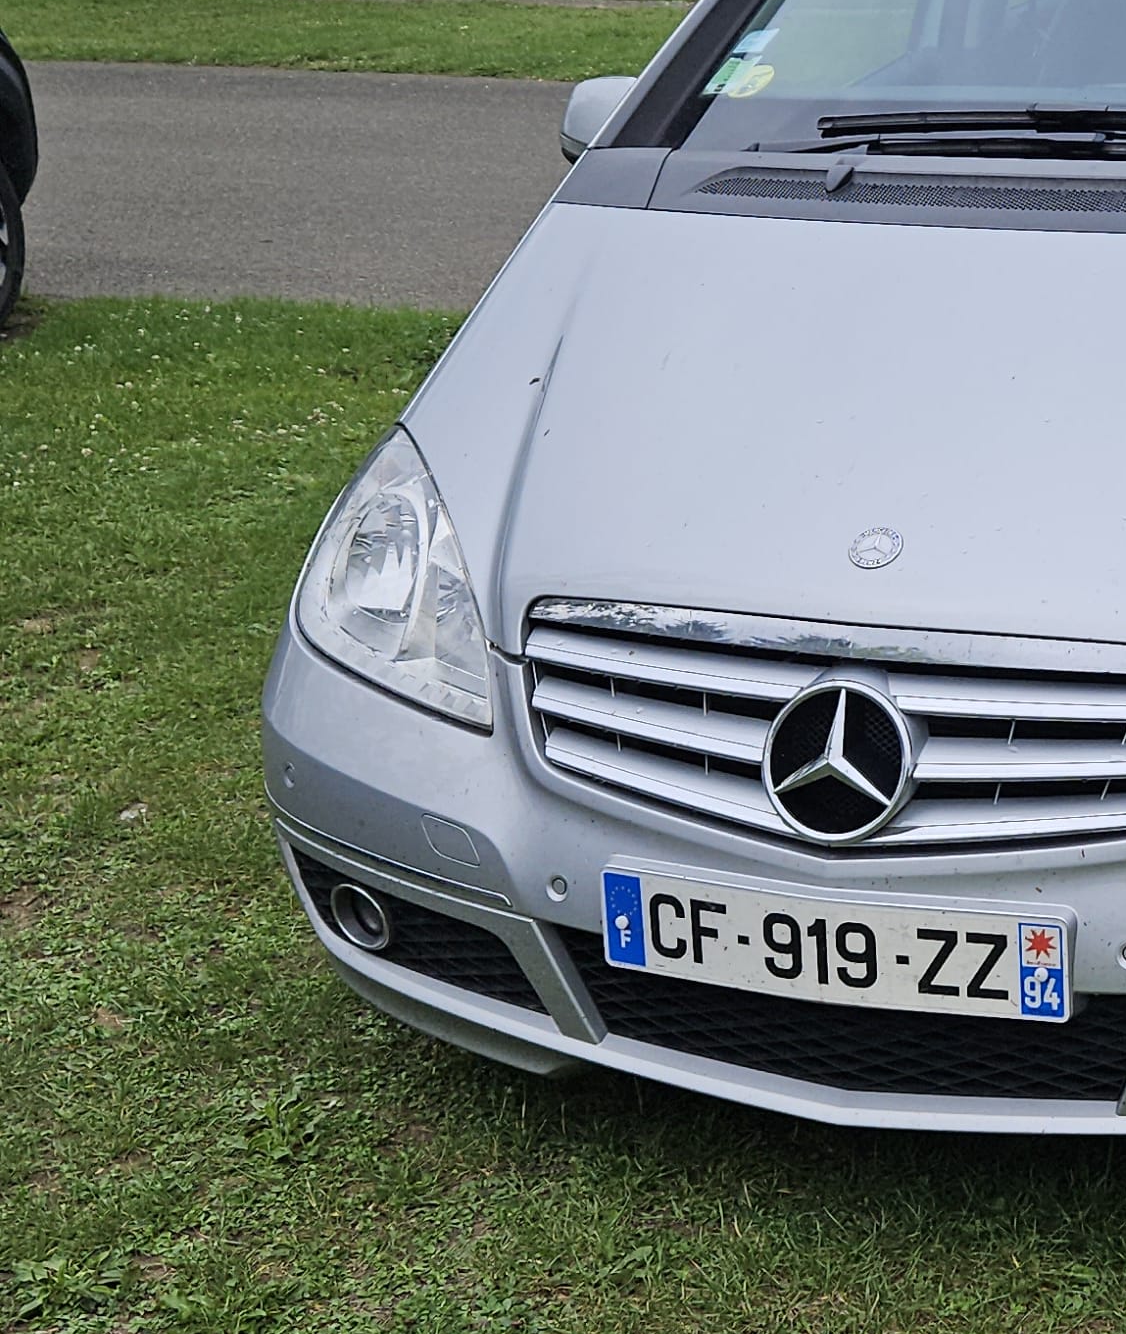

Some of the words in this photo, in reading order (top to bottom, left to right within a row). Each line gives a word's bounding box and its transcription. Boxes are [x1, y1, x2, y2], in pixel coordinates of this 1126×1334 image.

[620, 929, 632, 948] F
[649, 892, 1010, 1001] CF-919-ZZ
[1024, 975, 1061, 1011] 94
